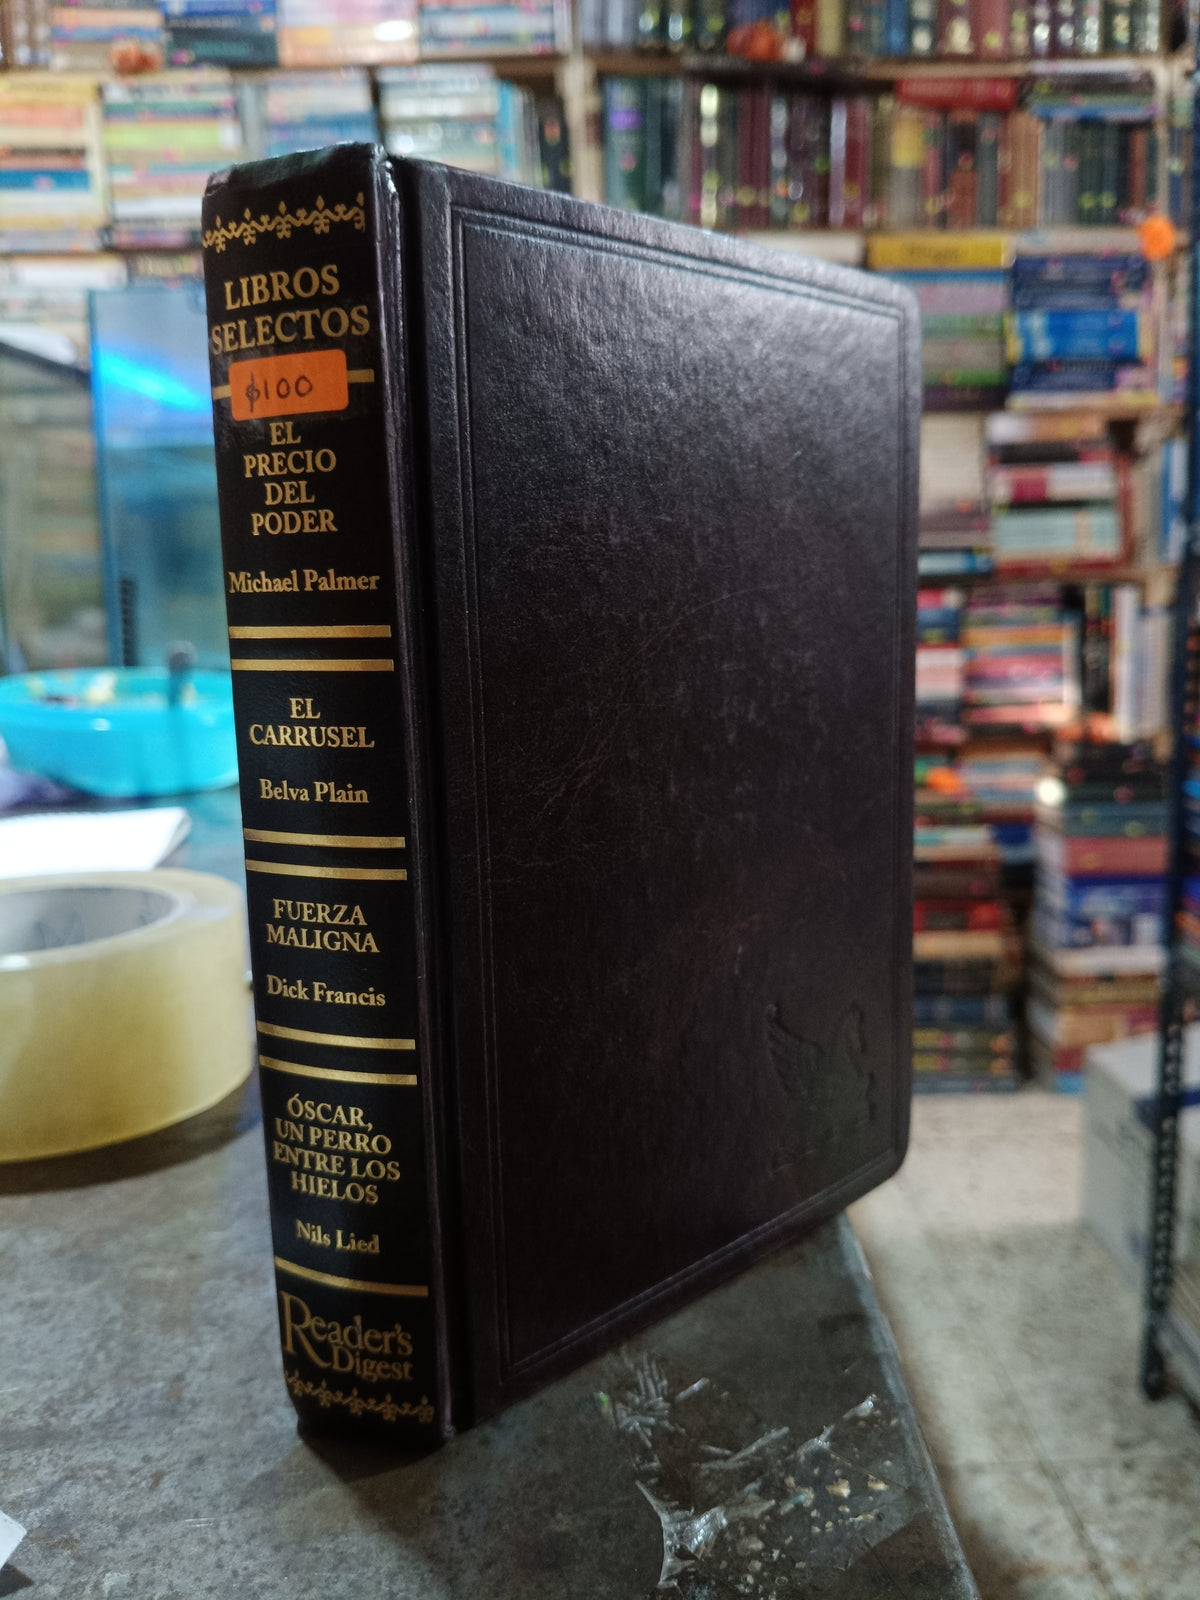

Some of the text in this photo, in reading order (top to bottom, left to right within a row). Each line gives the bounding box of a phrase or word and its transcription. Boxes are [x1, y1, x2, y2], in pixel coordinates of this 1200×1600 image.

[224, 264, 340, 311] LIBROS
[211, 304, 370, 354] SELECTOS
[269, 421, 301, 446] EL
[243, 448, 336, 478] PRECIO
[264, 480, 315, 506] DEL
[251, 509, 338, 536] PODER
[228, 569, 380, 593] Michael Palmer
[289, 697, 321, 719] EL
[249, 723, 375, 748] CARRUSEL
[259, 777, 369, 804] Belva Plain
[272, 898, 368, 926] FUERZA
[265, 923, 381, 953] MALIGNA
[266, 974, 386, 1007] Dick Francis
[286, 1093, 374, 1132] ÓSCAR,
[275, 1117, 392, 1155] UN PERRO
[273, 1140, 401, 1182] ENTRE LOS
[290, 1170, 379, 1206] HIELOS
[296, 1219, 381, 1254] Nils Lied
[280, 1291, 413, 1367] Reader's
[330, 1345, 414, 1383] Digest
